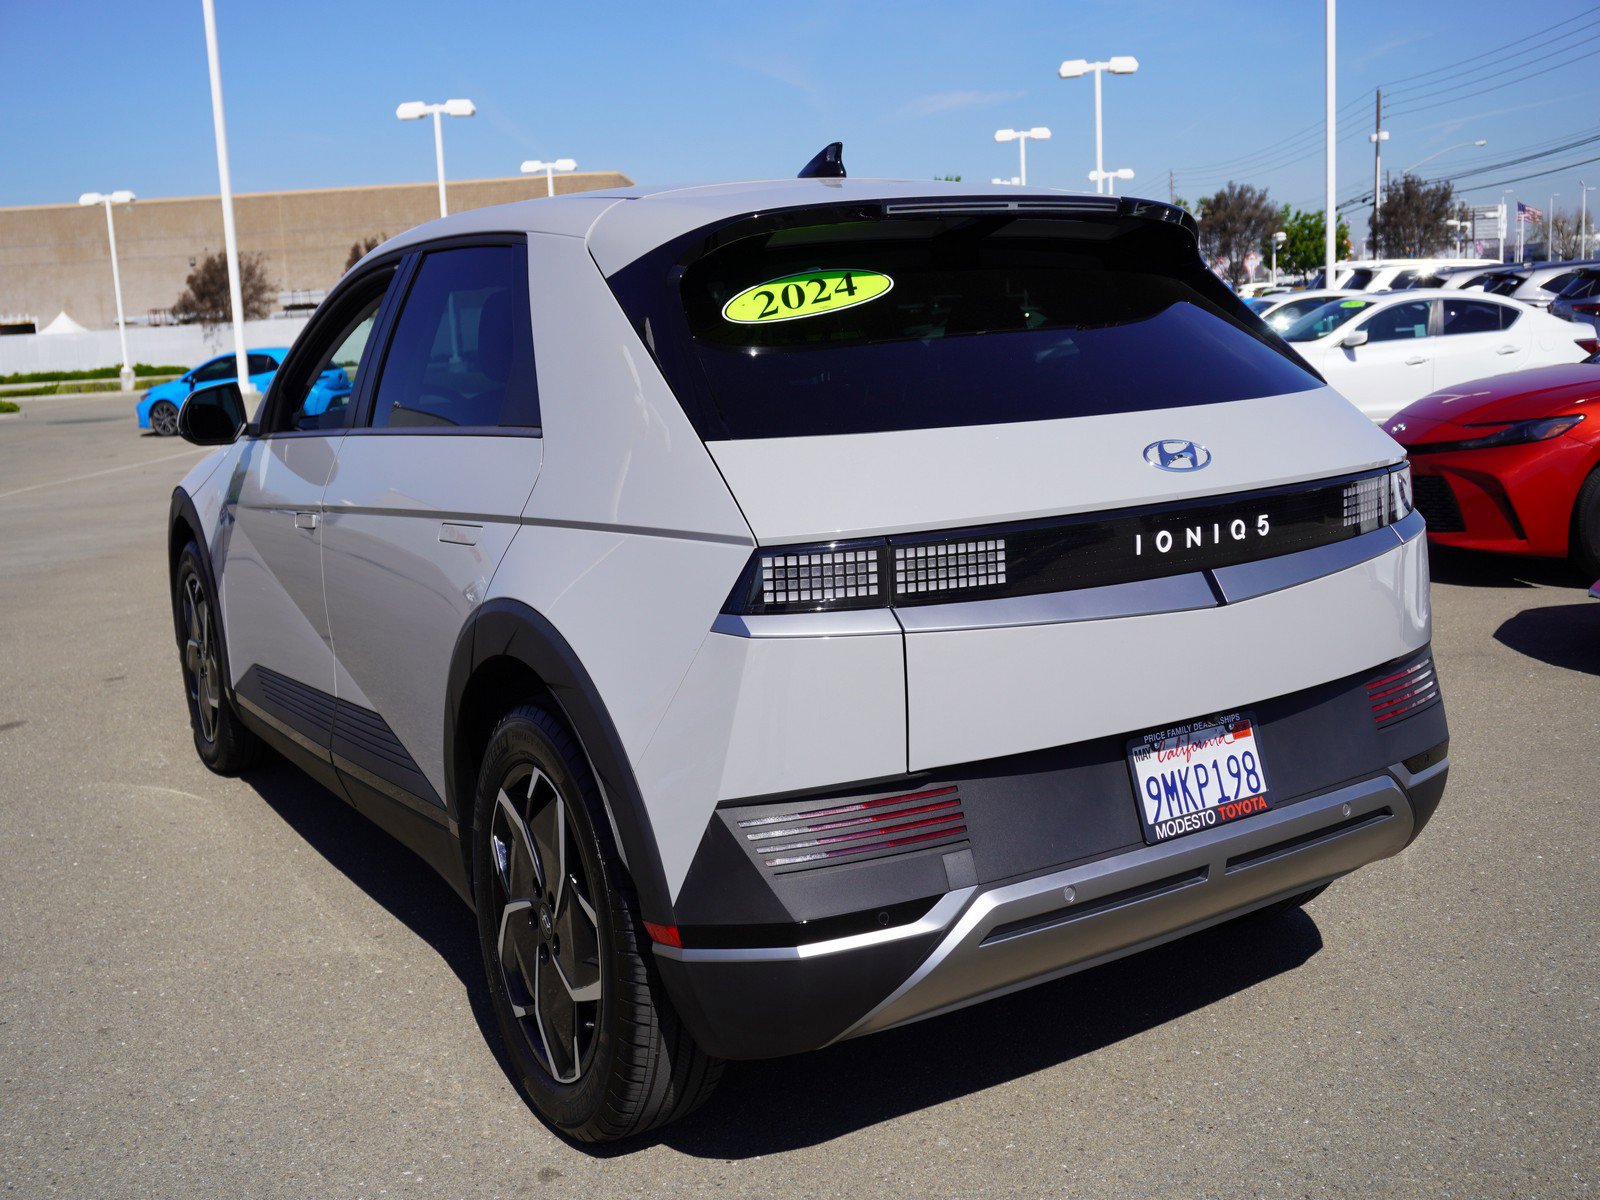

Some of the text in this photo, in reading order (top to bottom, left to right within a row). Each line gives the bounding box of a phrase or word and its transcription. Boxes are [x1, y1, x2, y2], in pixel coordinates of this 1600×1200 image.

[753, 272, 858, 319] 2024
[1136, 514, 1270, 556] IONIQ 5
[1134, 746, 1152, 763] MAY
[1143, 730, 1166, 744] PRICE
[1166, 725, 1193, 738] FAMILY
[1156, 733, 1235, 763] California
[1146, 751, 1261, 823] 9MKP198
[1155, 795, 1267, 839] MODESTO TOYOTA
